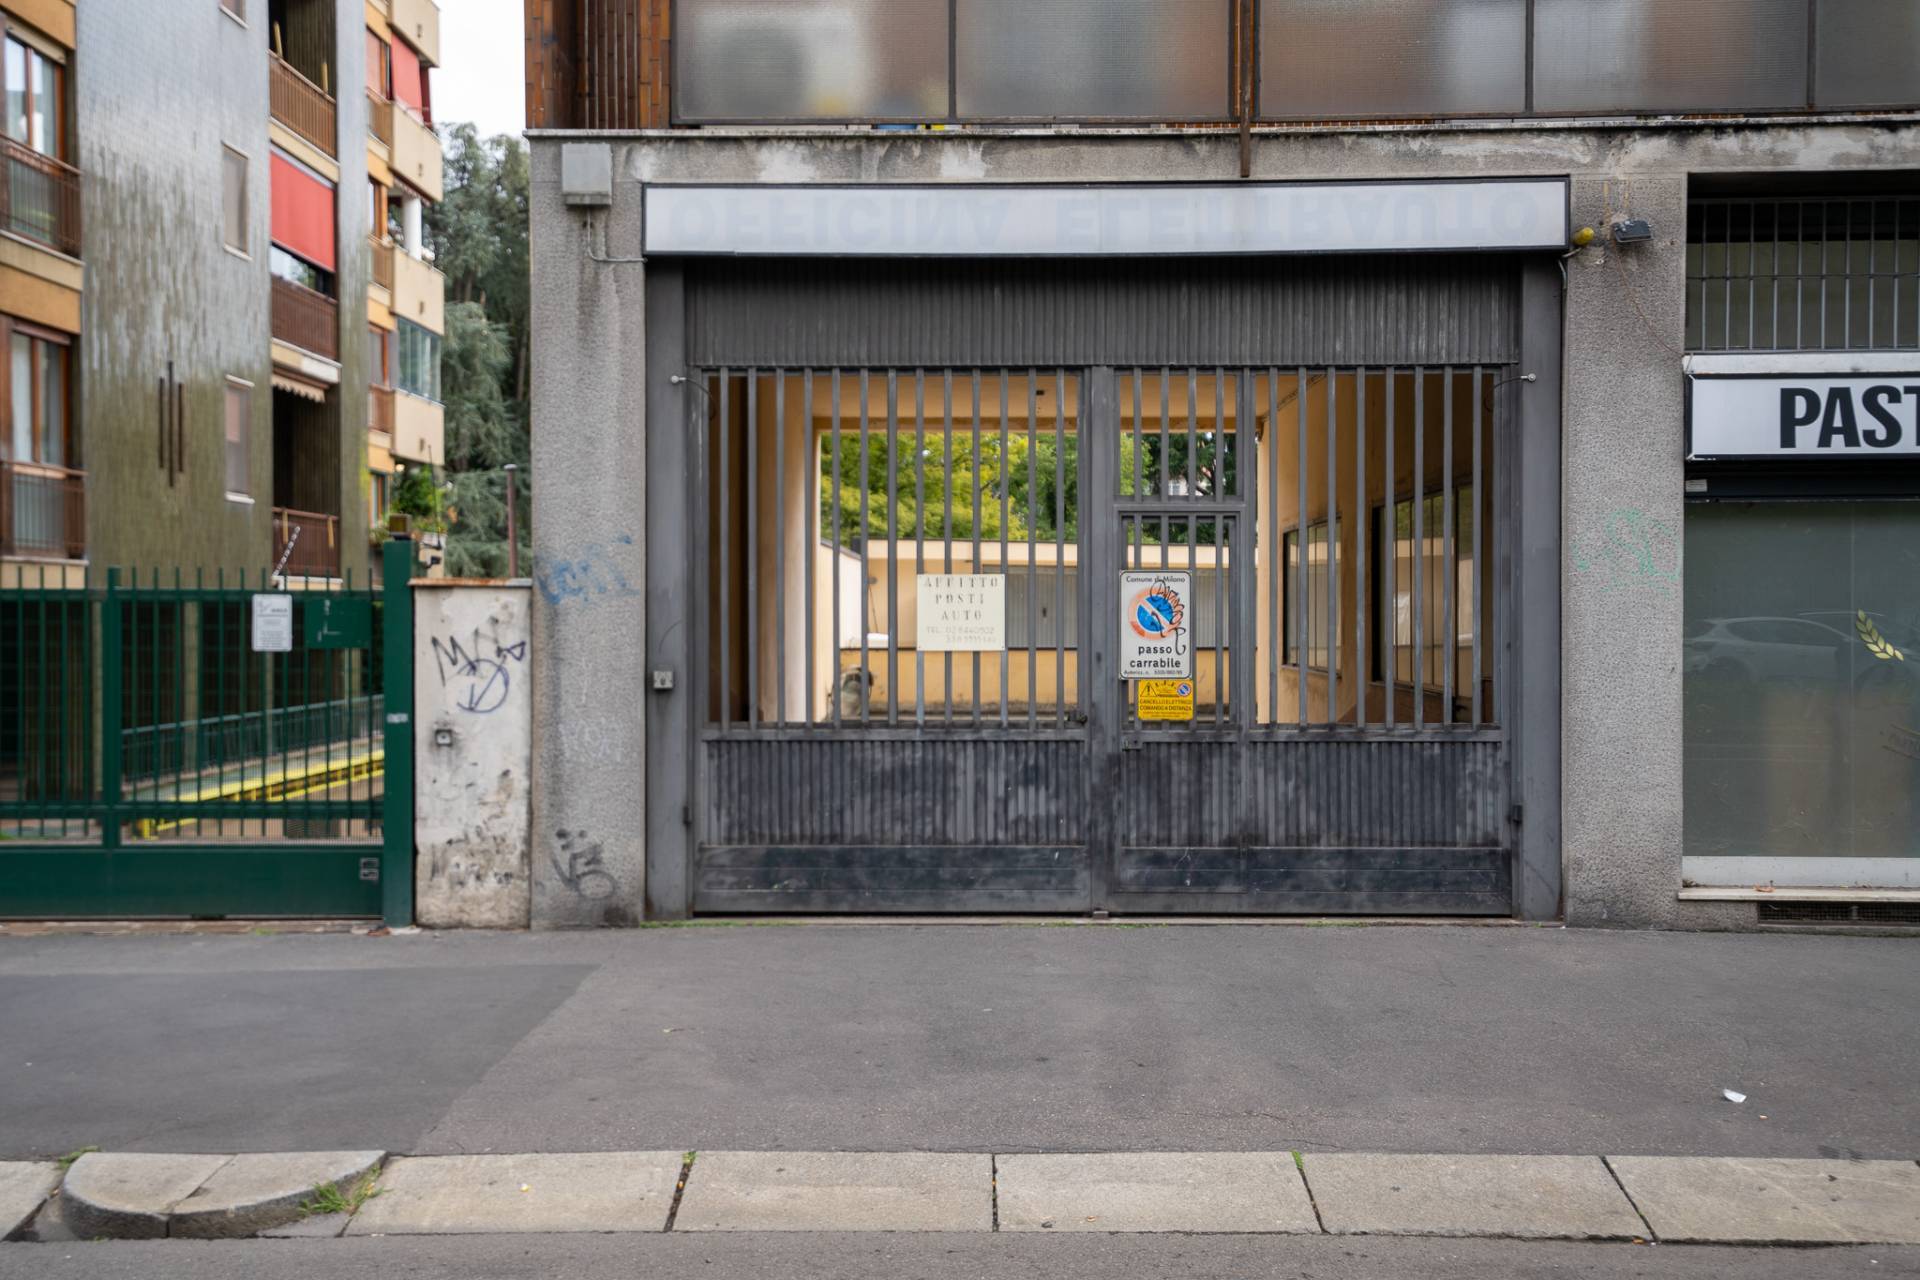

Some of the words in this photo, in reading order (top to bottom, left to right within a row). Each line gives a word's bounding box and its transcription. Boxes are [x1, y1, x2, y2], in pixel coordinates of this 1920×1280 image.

[925, 577, 998, 588] AFFITTO
[935, 593, 984, 604] POSTI
[942, 610, 981, 620] AUTO
[1138, 646, 1172, 656] passo
[1130, 658, 1181, 668] carrabile
